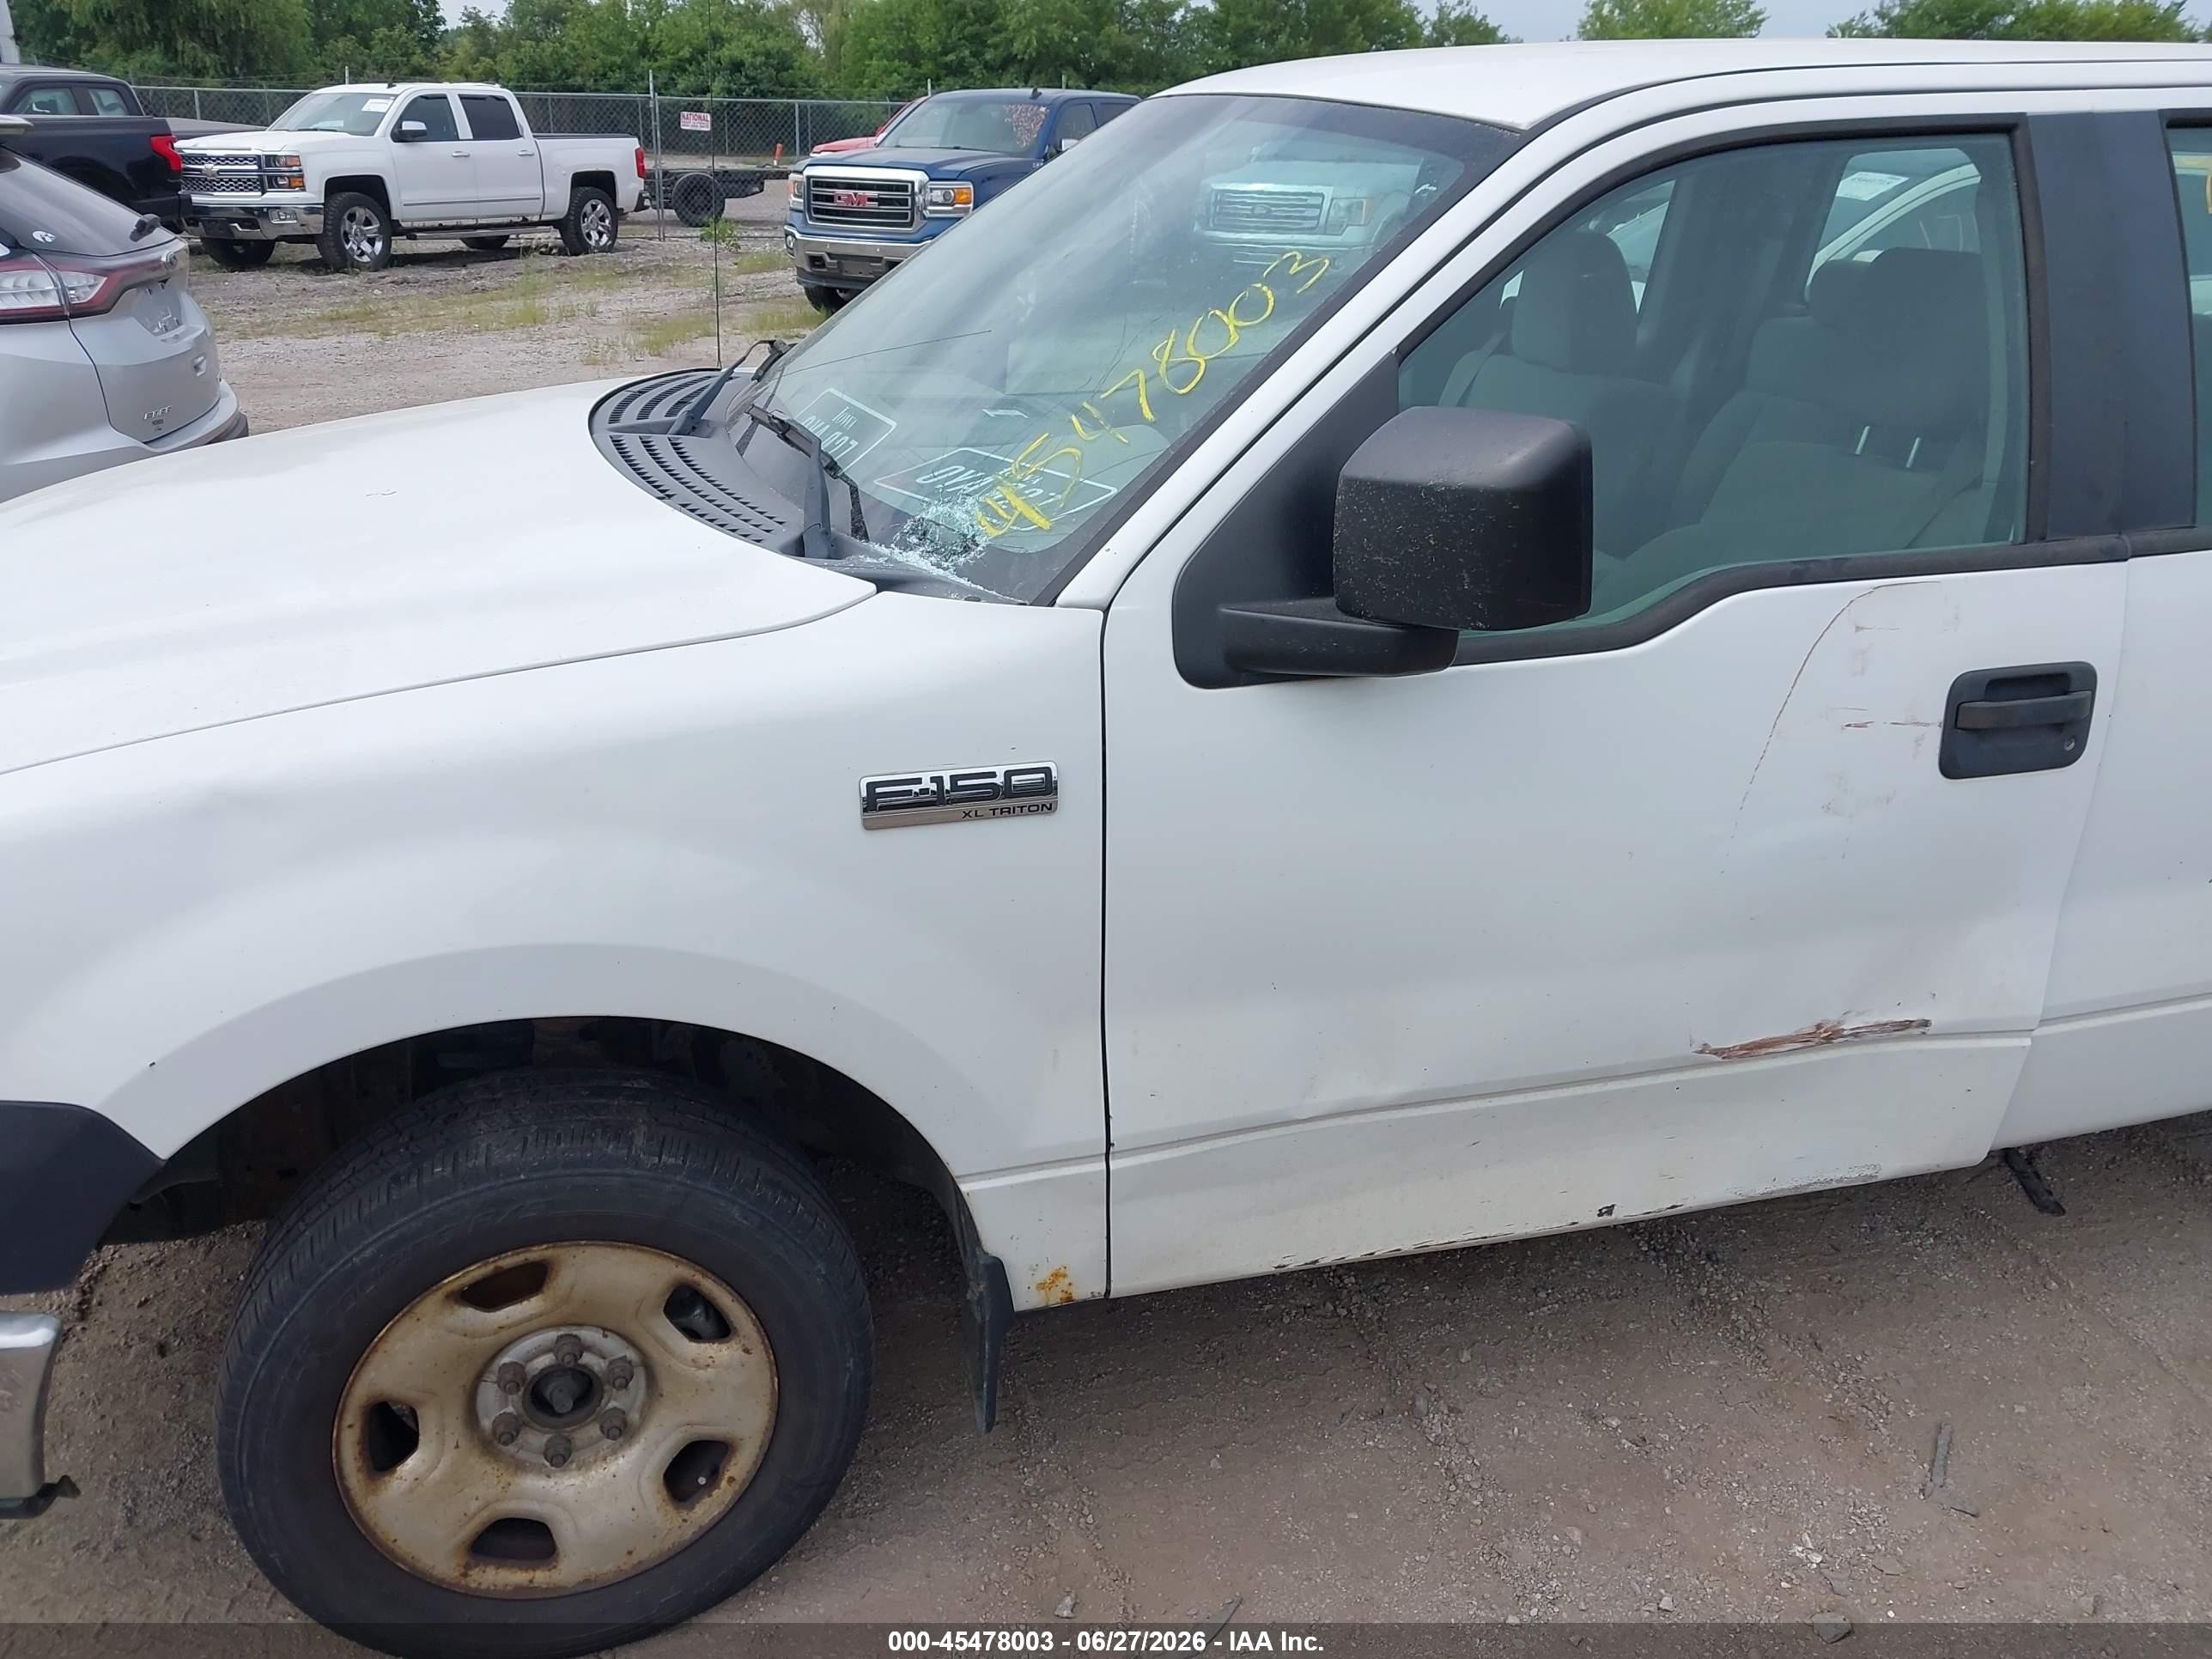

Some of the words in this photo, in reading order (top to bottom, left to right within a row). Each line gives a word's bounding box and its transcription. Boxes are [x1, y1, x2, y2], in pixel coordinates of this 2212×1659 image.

[682, 113, 709, 122] NATIONAL
[833, 192, 879, 207] GMC
[976, 251, 1330, 538] 45478003
[961, 809, 984, 819] XL
[988, 802, 1054, 817] TRITON
